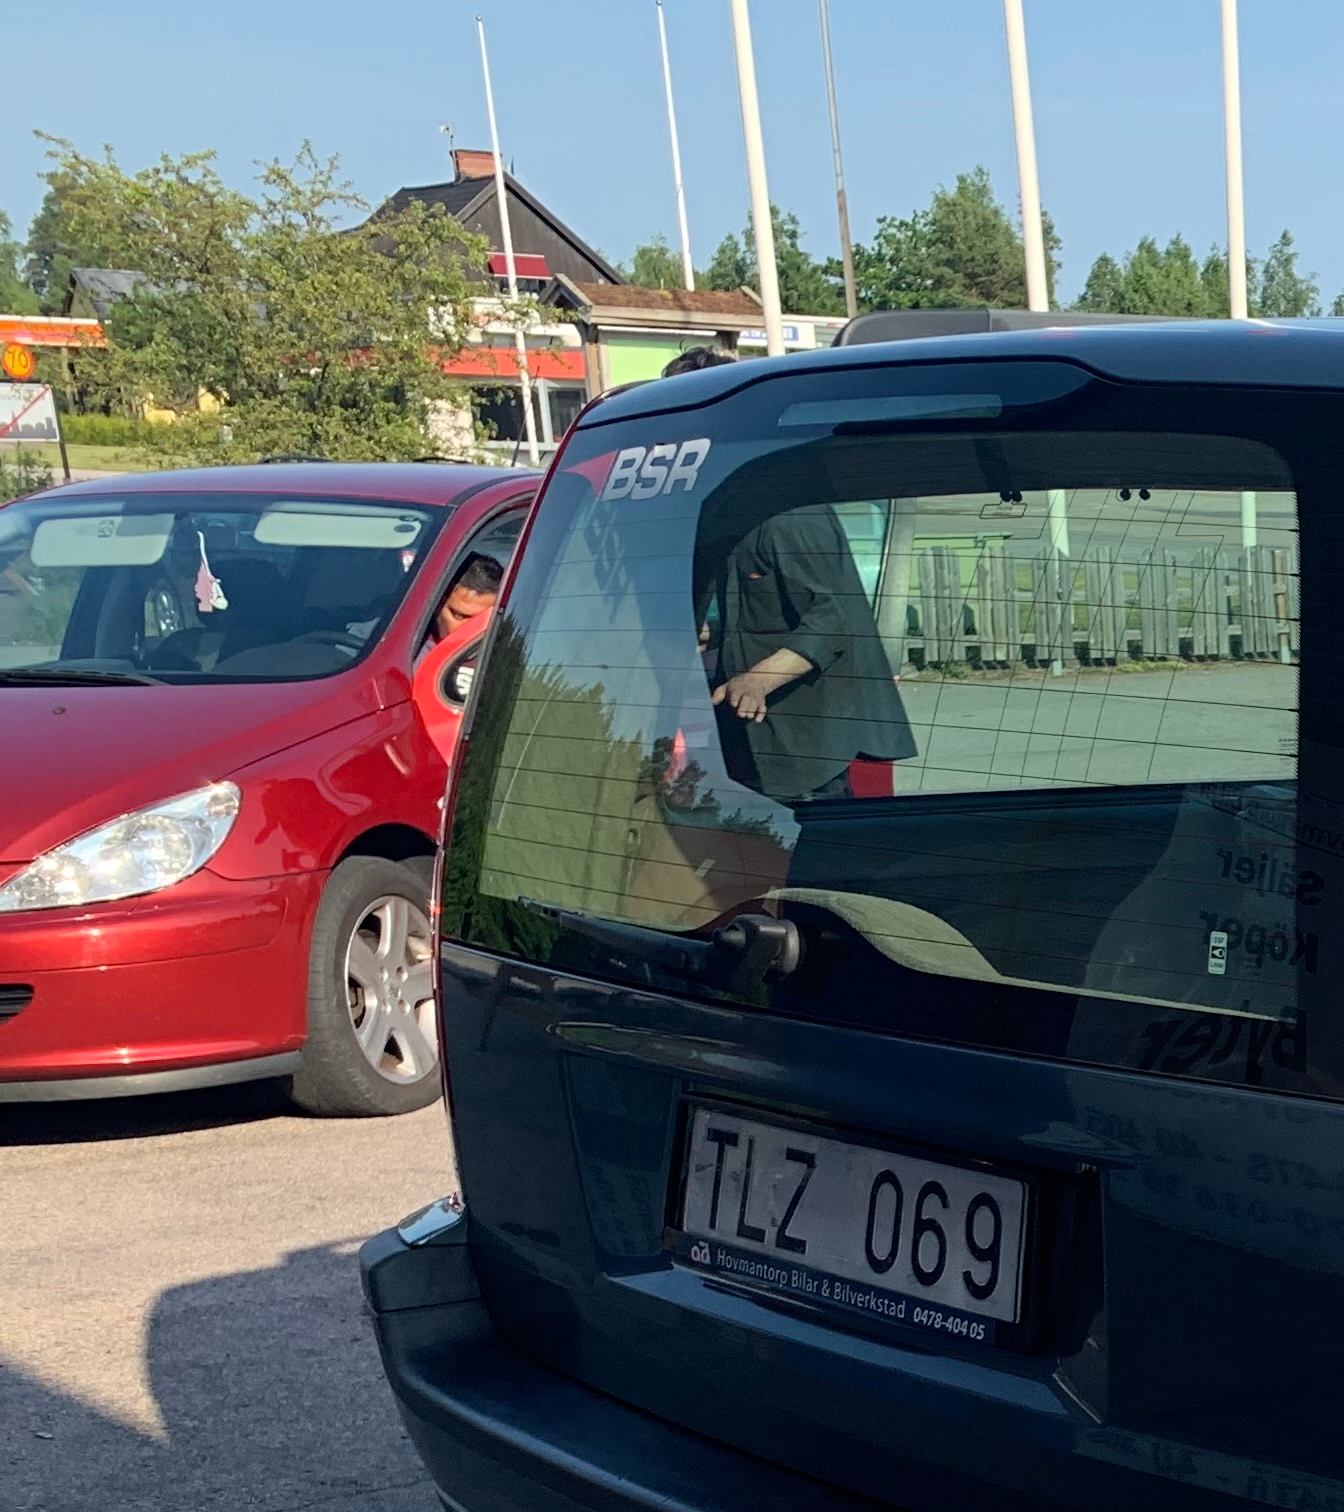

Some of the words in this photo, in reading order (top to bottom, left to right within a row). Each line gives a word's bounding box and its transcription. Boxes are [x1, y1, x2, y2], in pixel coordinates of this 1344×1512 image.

[601, 437, 711, 502] BSR
[704, 1128, 817, 1255] TLZ
[863, 1168, 1004, 1301] 069
[717, 1249, 788, 1287] Hovmantorp
[791, 1270, 819, 1293] Bilar
[821, 1279, 831, 1296] &
[833, 1281, 906, 1319] Bilverkstad
